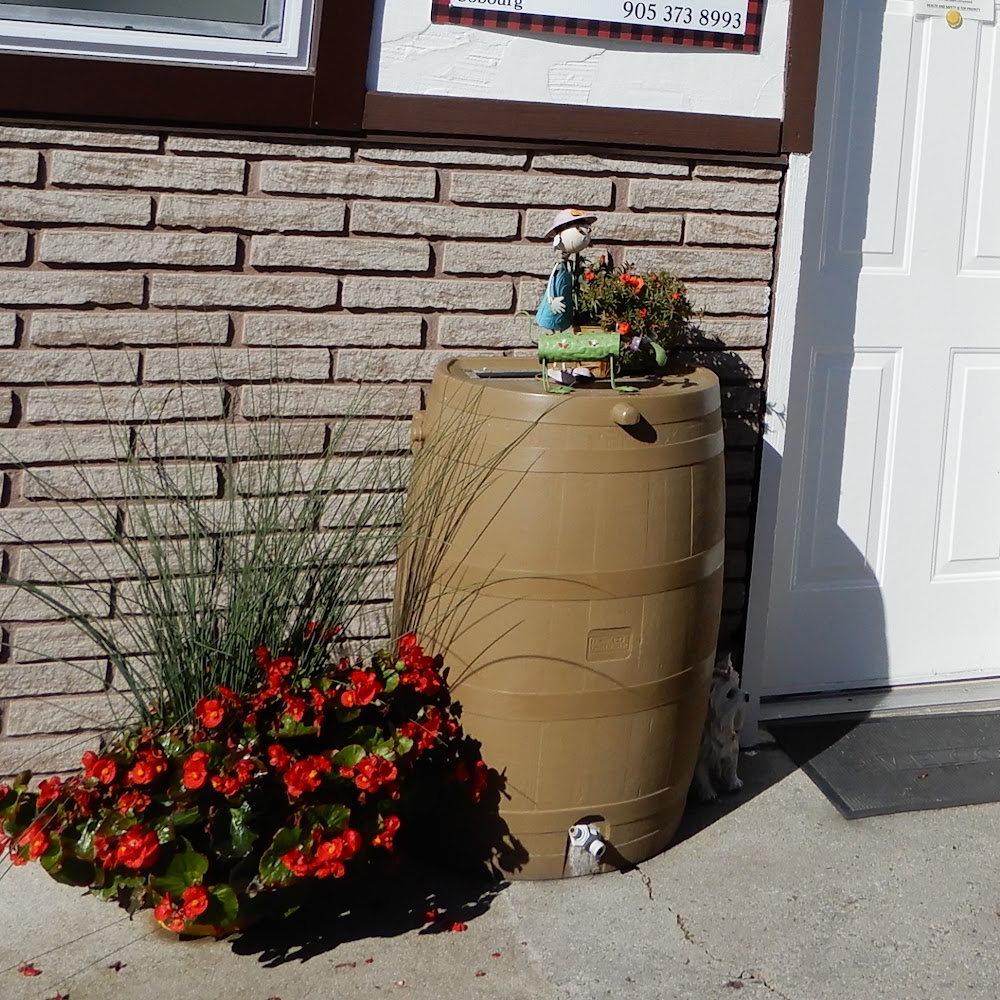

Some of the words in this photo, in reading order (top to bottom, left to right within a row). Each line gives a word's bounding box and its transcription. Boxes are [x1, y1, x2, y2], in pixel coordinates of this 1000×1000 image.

[623, 0, 657, 21] 905
[662, 5, 693, 25] 373
[698, 9, 744, 30] 8993
